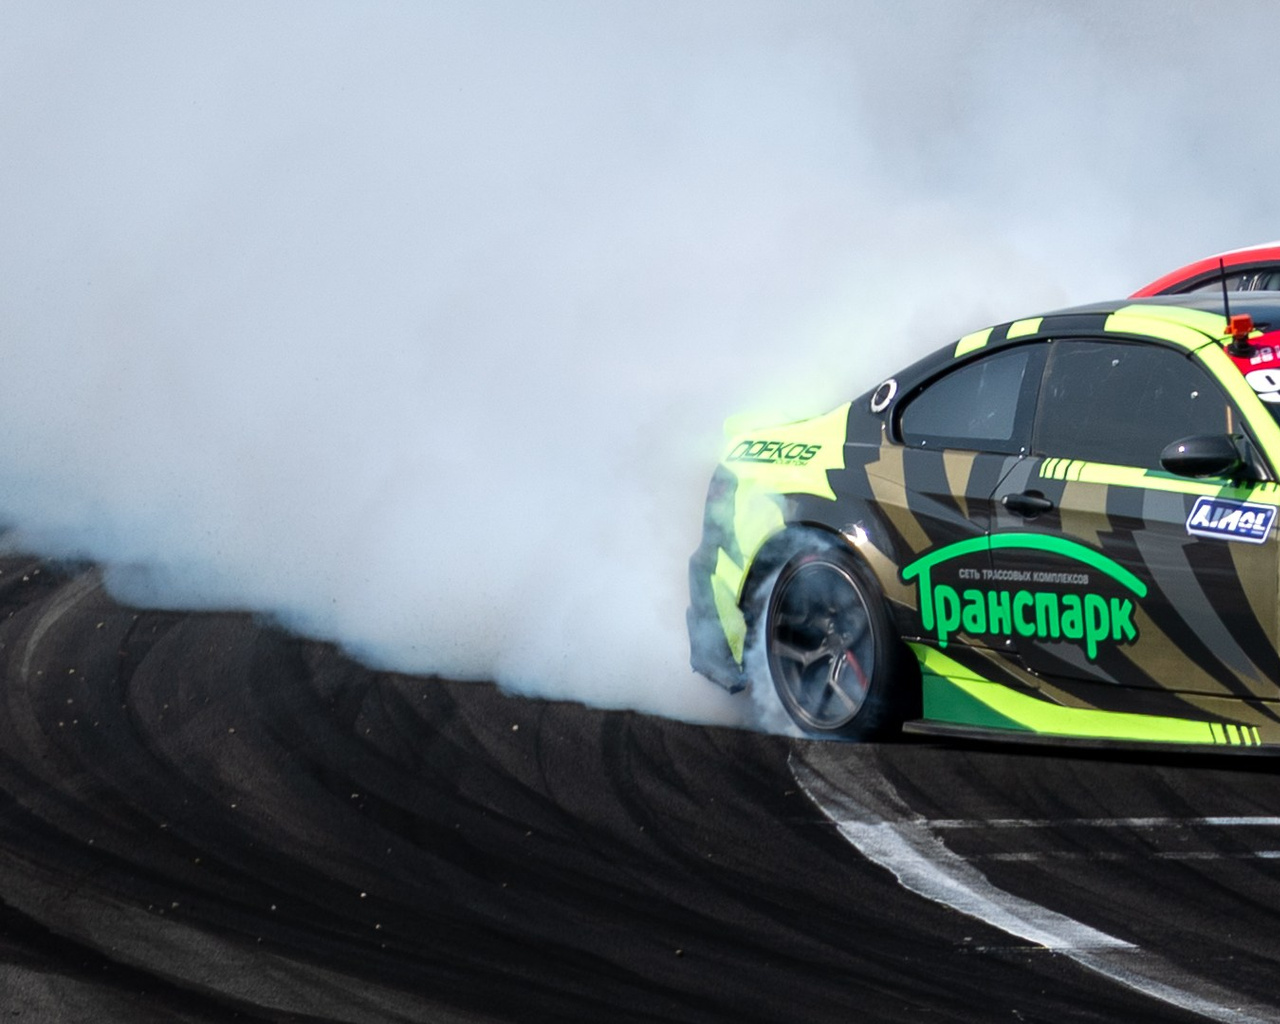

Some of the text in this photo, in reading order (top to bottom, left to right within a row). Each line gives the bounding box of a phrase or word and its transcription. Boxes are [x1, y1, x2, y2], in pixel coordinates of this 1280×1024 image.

[1190, 504, 1267, 532] AIMOL
[959, 568, 1089, 585] СЕТЬ ТРАССОВЫХ КОМПЛЕКСОВ
[902, 533, 1147, 660] Транспарк
